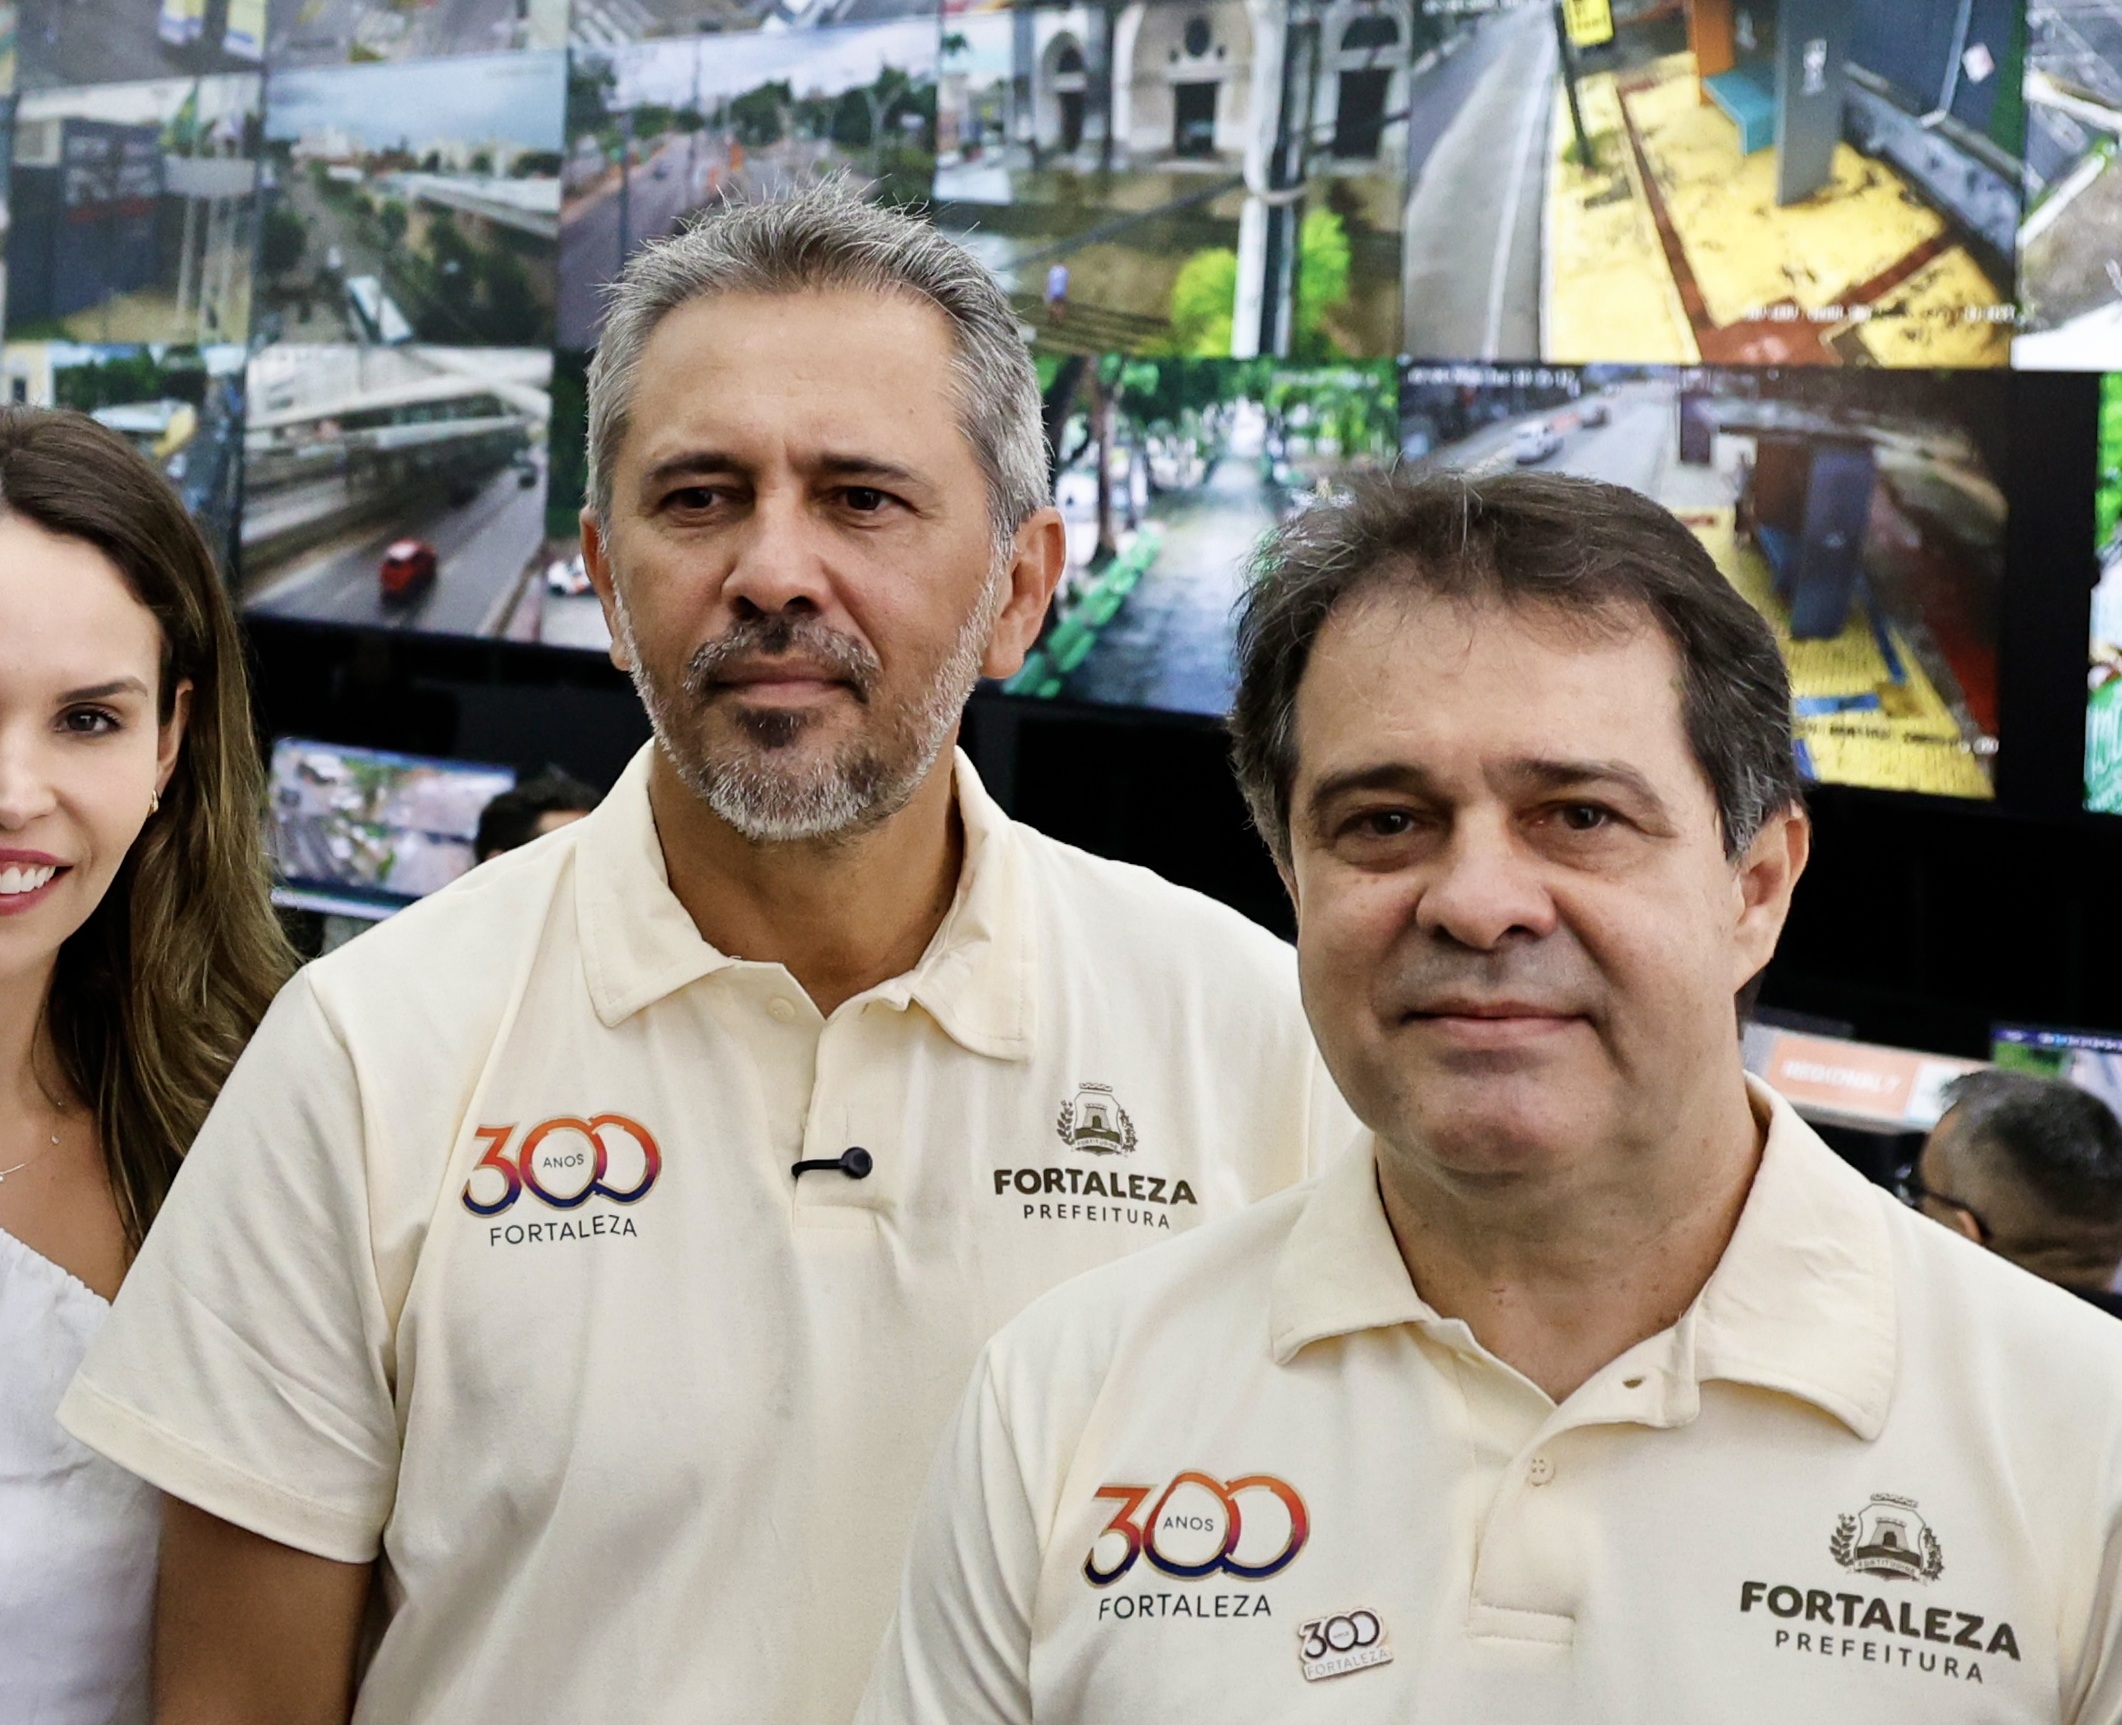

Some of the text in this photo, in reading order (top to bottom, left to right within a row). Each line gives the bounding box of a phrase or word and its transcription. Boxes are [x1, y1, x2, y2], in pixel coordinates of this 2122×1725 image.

[461, 1113, 661, 1218] 300
[543, 1153, 584, 1168] ANOS
[994, 1168, 1198, 1205] FORTALEZA
[490, 1215, 637, 1246] FORTALEZA
[1023, 1204, 1170, 1229] PREFEITURA
[1081, 1469, 1310, 1588] 300
[1163, 1516, 1214, 1532] ANOS
[1098, 1594, 1272, 1620] FORTALEZA
[1740, 1581, 2021, 1661] FORTALEZA
[1303, 1610, 1381, 1659] 300
[1307, 1648, 1389, 1677] FORTALEZA
[1775, 1630, 1983, 1683] PREFEITURA
